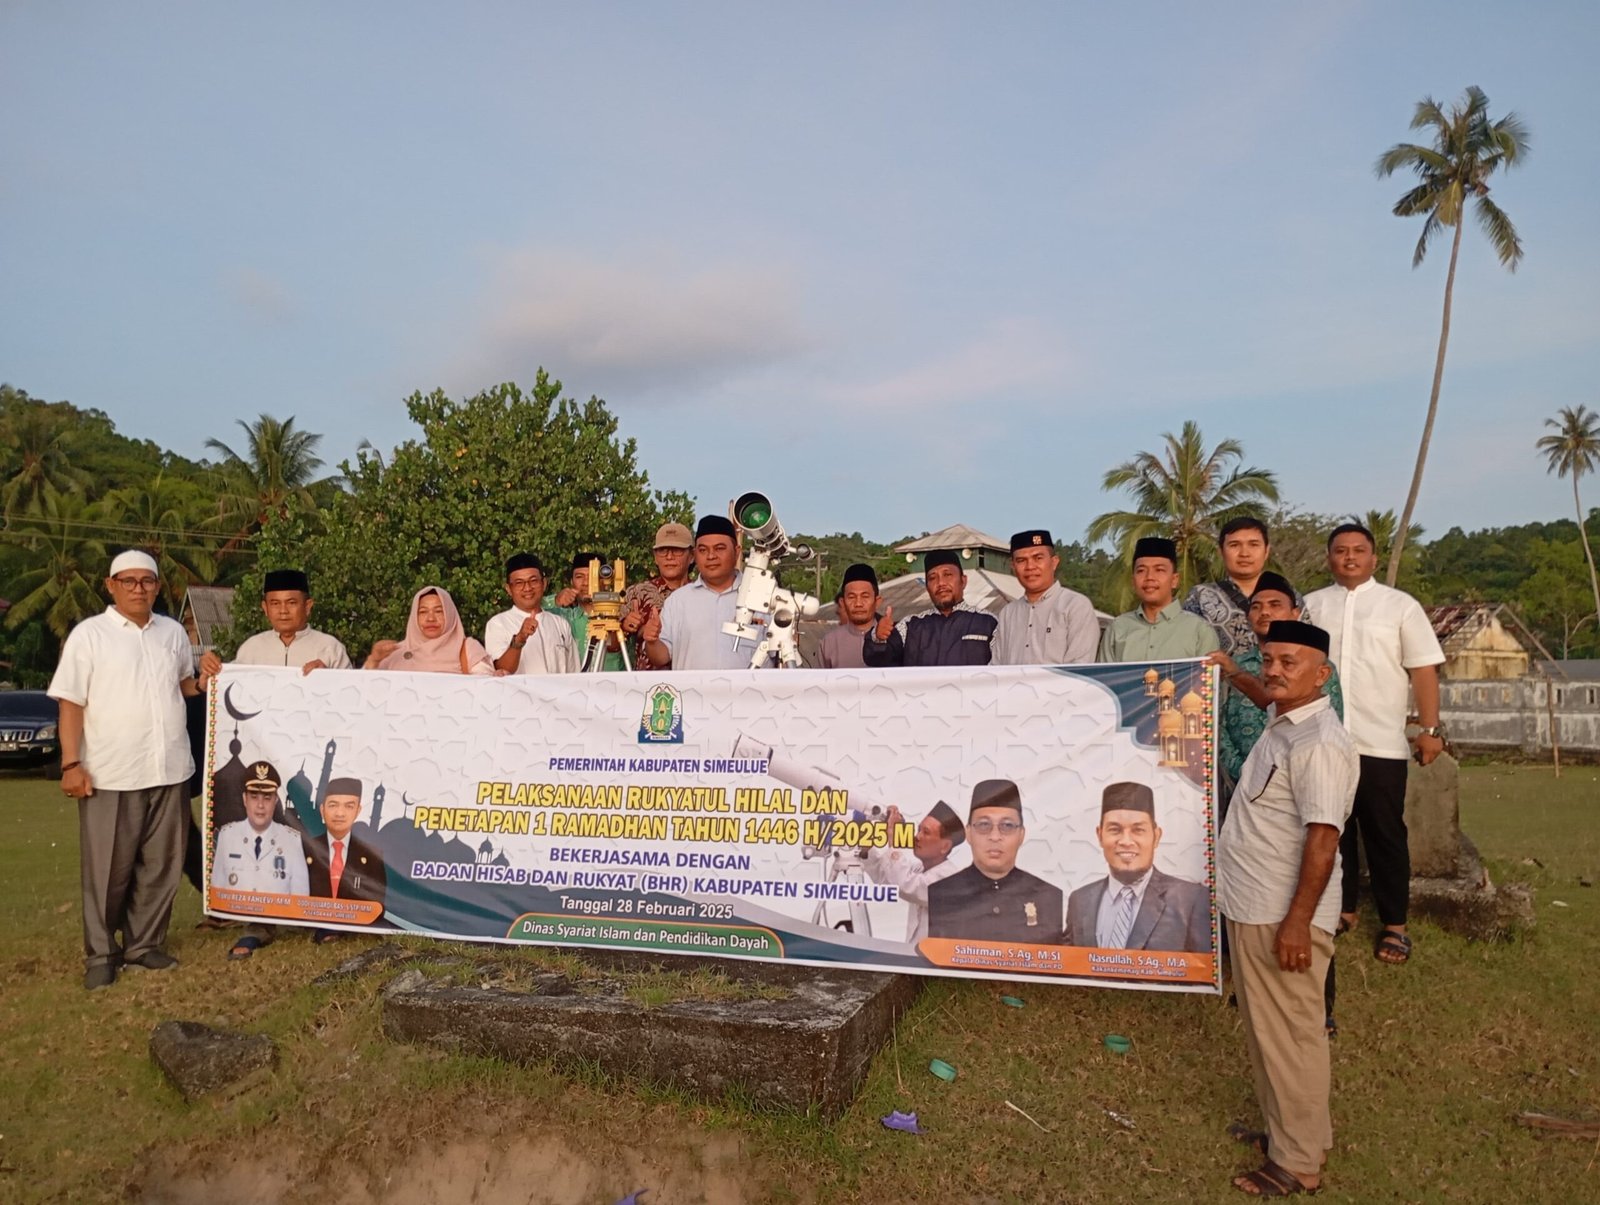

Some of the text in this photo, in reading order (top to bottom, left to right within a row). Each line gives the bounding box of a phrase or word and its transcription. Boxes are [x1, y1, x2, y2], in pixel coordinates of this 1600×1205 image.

[549, 757, 768, 774] PEMERINTAH KABUPATEN SIMEULUE
[477, 781, 848, 816] PELAKSANAAN RUKYATUL HILAL DAN
[414, 806, 915, 850] PENETAPAN 1 RAMADHAN TAHUN 1446 H/2025 M
[550, 847, 751, 870] BEKERJASAMA DENGAN
[412, 863, 898, 903] BADAN HISAB DAN RUKYAT (BHR) KABUPATEN SIMEULUE
[560, 896, 734, 919] Tanggal 28 Februari 2025
[523, 920, 769, 951] Dinas Syariat Islam dan Pendidikan Dayah
[954, 944, 1005, 958] Sahirman,
